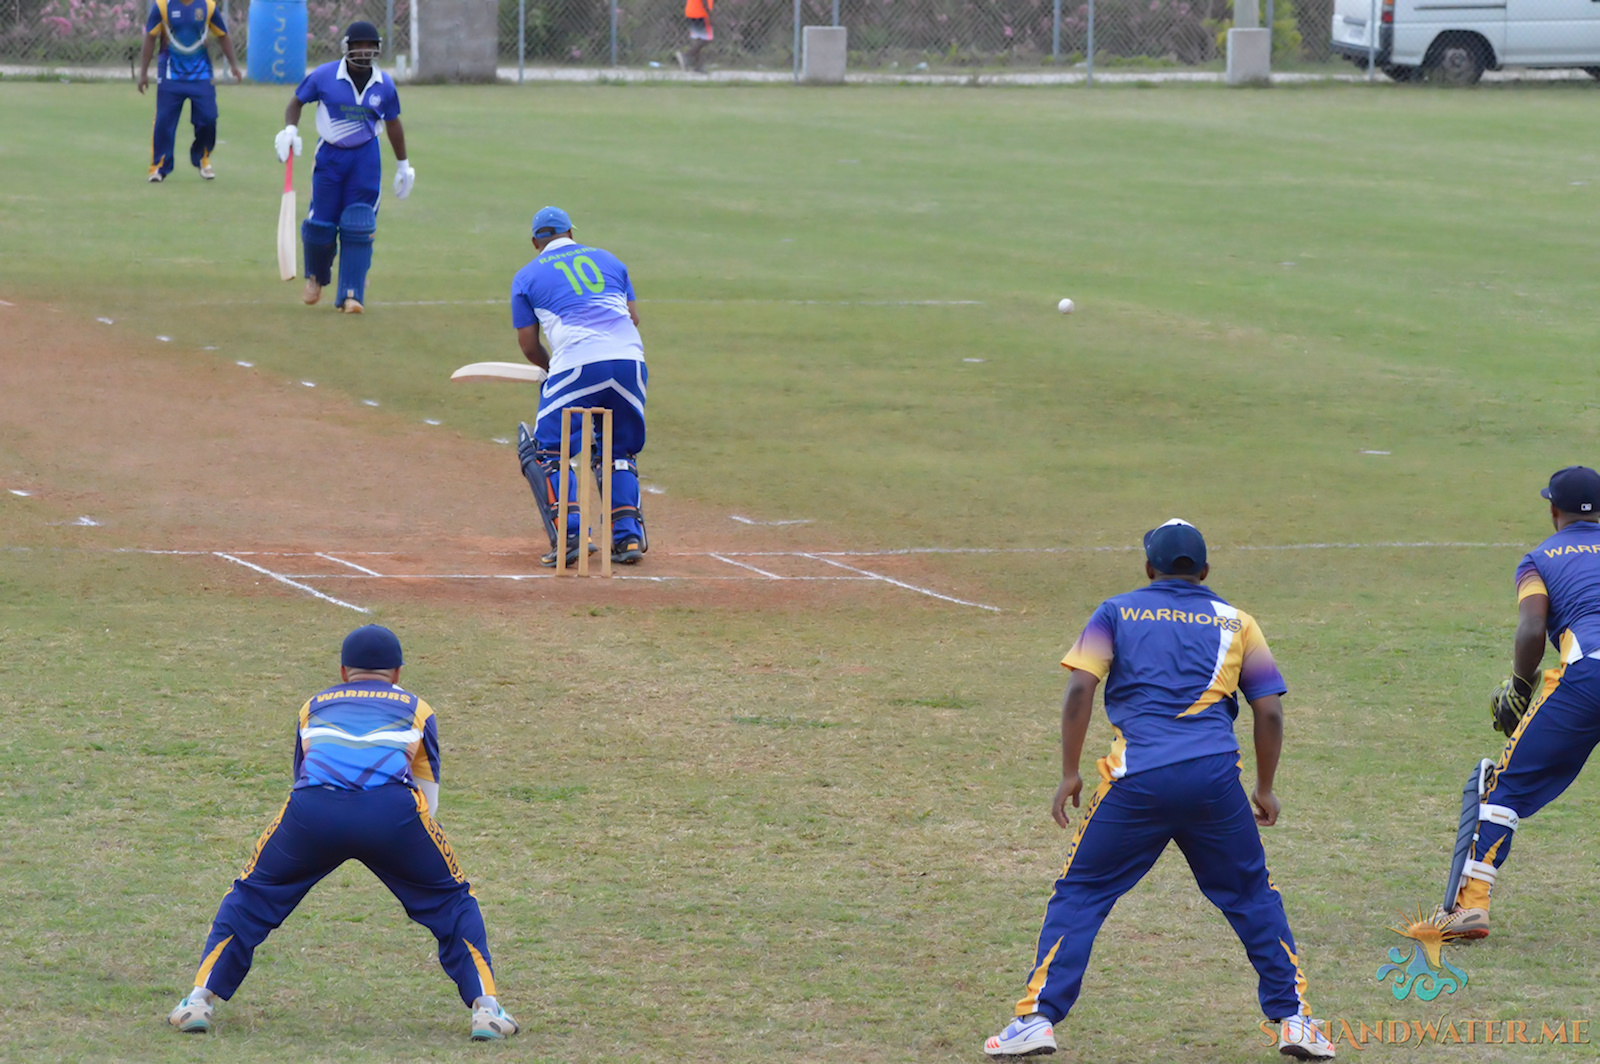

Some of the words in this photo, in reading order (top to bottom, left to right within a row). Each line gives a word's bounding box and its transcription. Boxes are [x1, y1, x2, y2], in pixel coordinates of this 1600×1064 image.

[538, 246, 597, 264] RANGERS
[553, 255, 605, 295] 10
[1543, 544, 1600, 558] WARR
[1120, 606, 1242, 632] WARRIORS
[316, 689, 411, 704] WARRIORS
